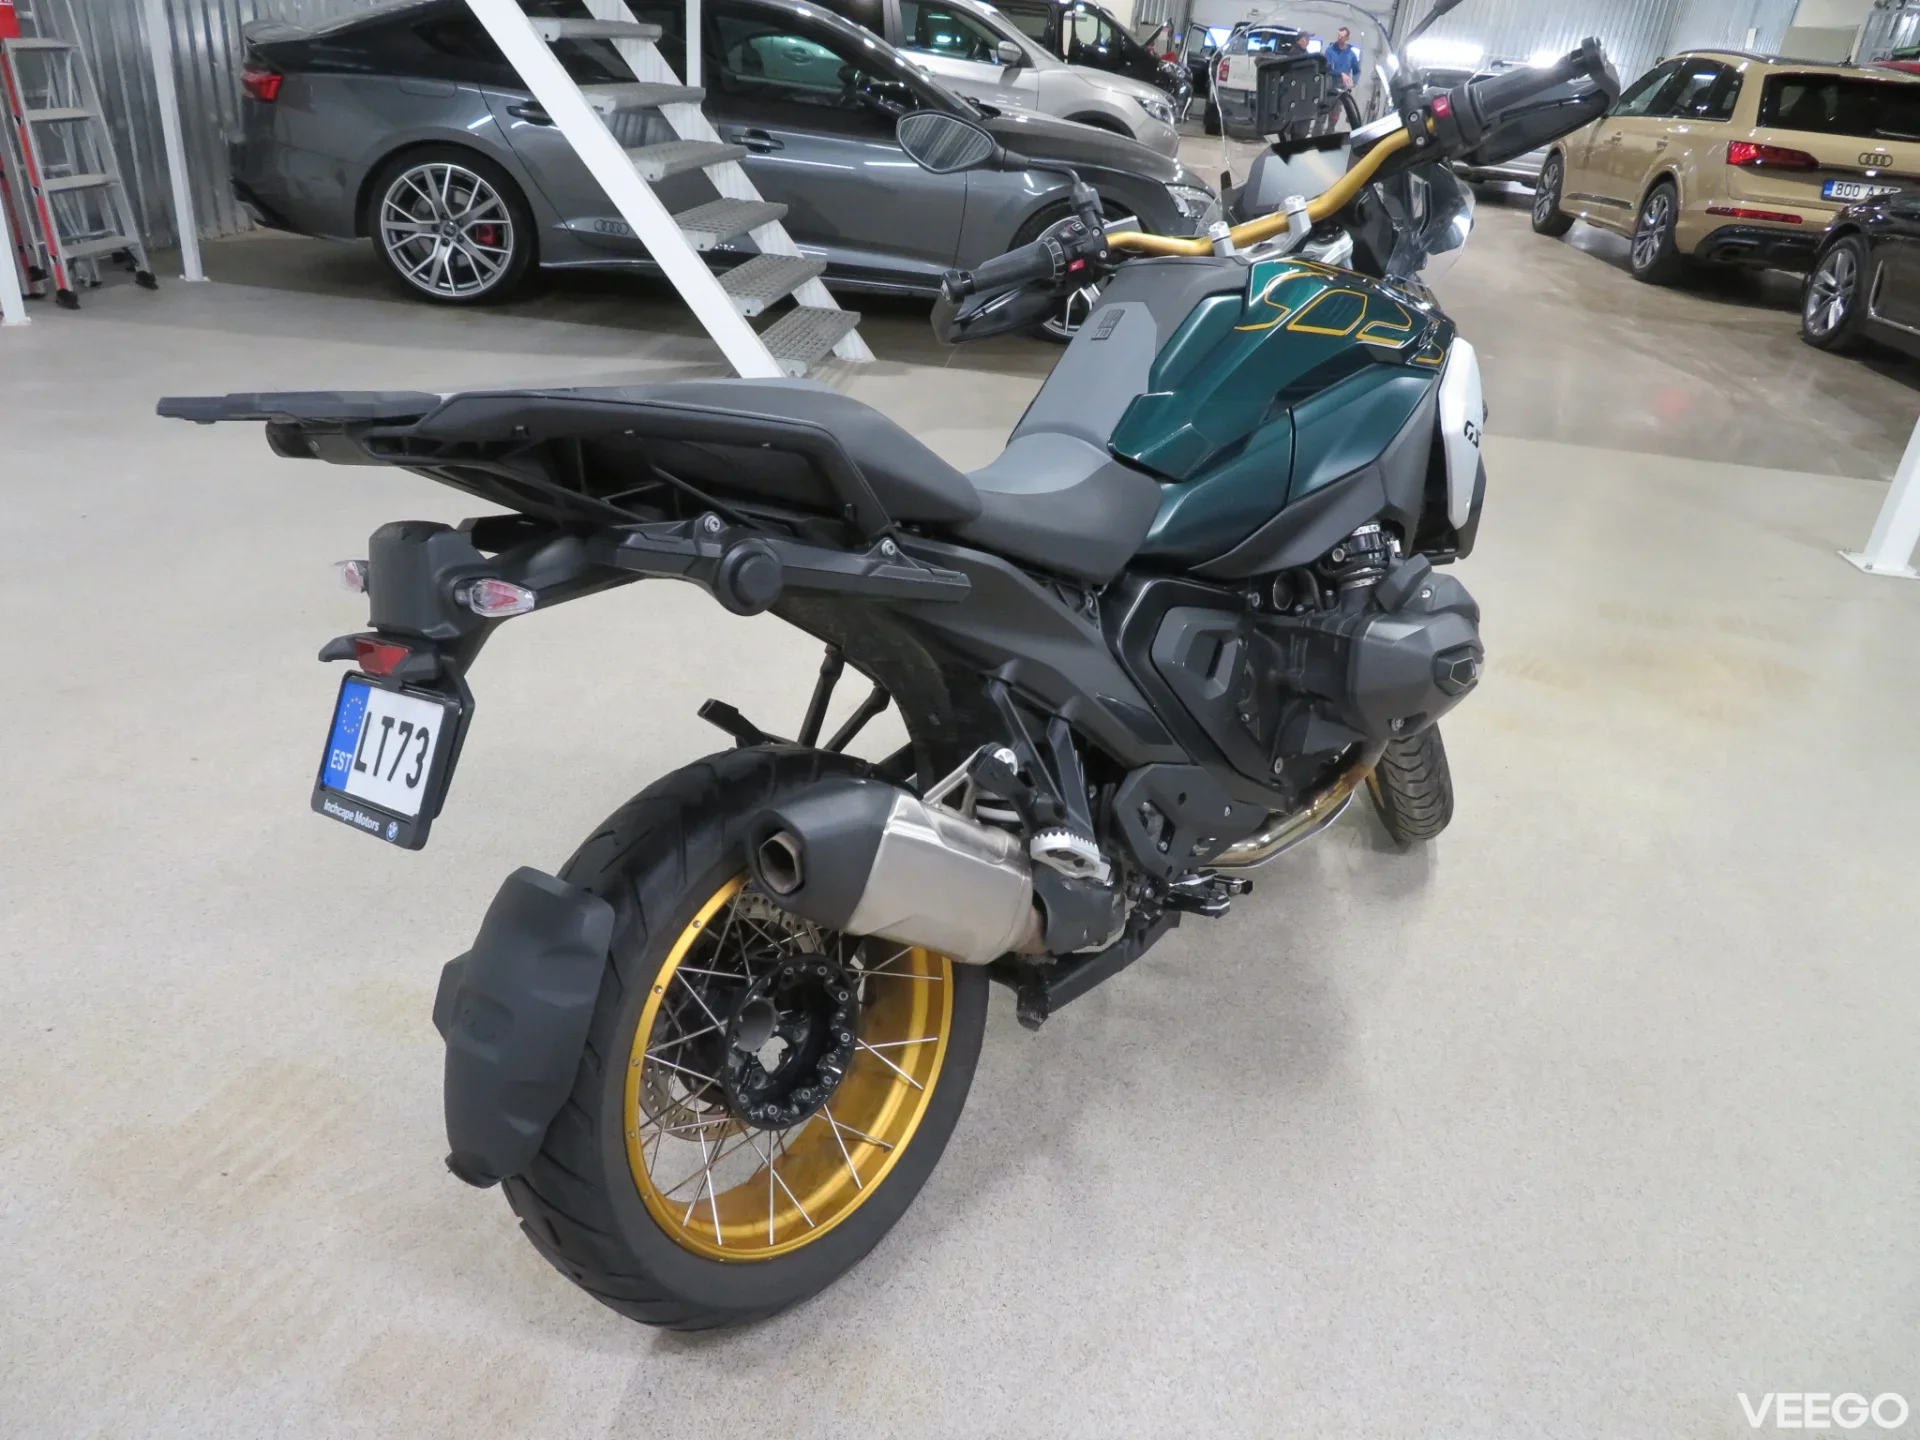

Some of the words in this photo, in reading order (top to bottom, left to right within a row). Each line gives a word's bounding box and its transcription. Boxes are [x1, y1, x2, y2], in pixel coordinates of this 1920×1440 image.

[1836, 183, 1860, 197] 800
[1463, 420, 1481, 449] GS
[330, 749, 352, 773] EST
[353, 711, 430, 789] LT73
[324, 799, 354, 821] Inchcape
[354, 810, 380, 832] Motors
